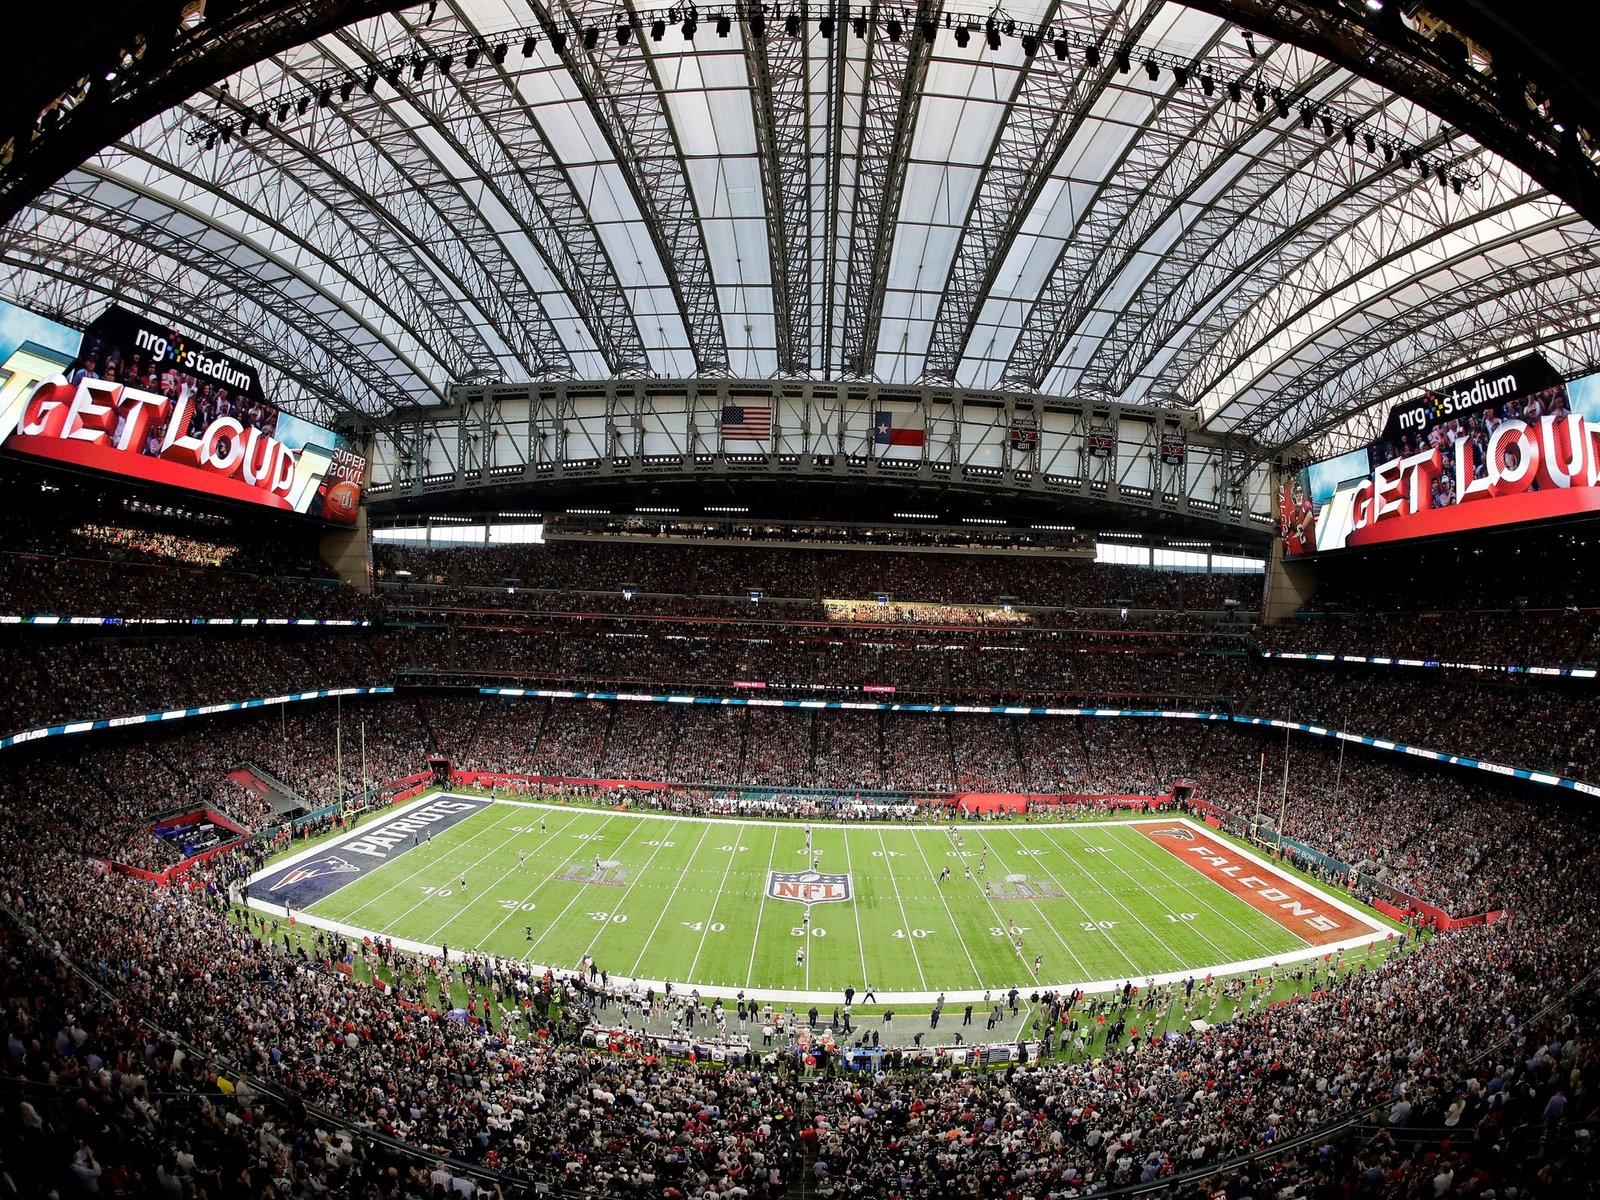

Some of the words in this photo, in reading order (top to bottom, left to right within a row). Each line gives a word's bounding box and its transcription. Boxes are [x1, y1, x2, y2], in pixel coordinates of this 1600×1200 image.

[135, 328, 168, 361] nrg
[185, 348, 251, 392] stadium
[1398, 406, 1426, 431] nrg
[1443, 373, 1517, 416] stadium
[16, 372, 170, 452] GET
[160, 391, 296, 493] LOUD
[1017, 442, 1030, 450] 2011
[332, 447, 366, 471] SUPER
[329, 461, 364, 486] BOWL
[1350, 447, 1441, 531] GET
[341, 800, 476, 858] PATRIOTS
[421, 886, 453, 897] 10
[776, 881, 843, 900] NFL
[1186, 845, 1341, 932] FALCONS
[500, 900, 536, 911] 20
[591, 911, 628, 923] 30
[1166, 912, 1197, 923] 10
[688, 921, 726, 932] 40
[989, 926, 1024, 937] 30
[1079, 920, 1115, 931] 20
[790, 926, 828, 938] 50
[891, 928, 928, 939] 40
